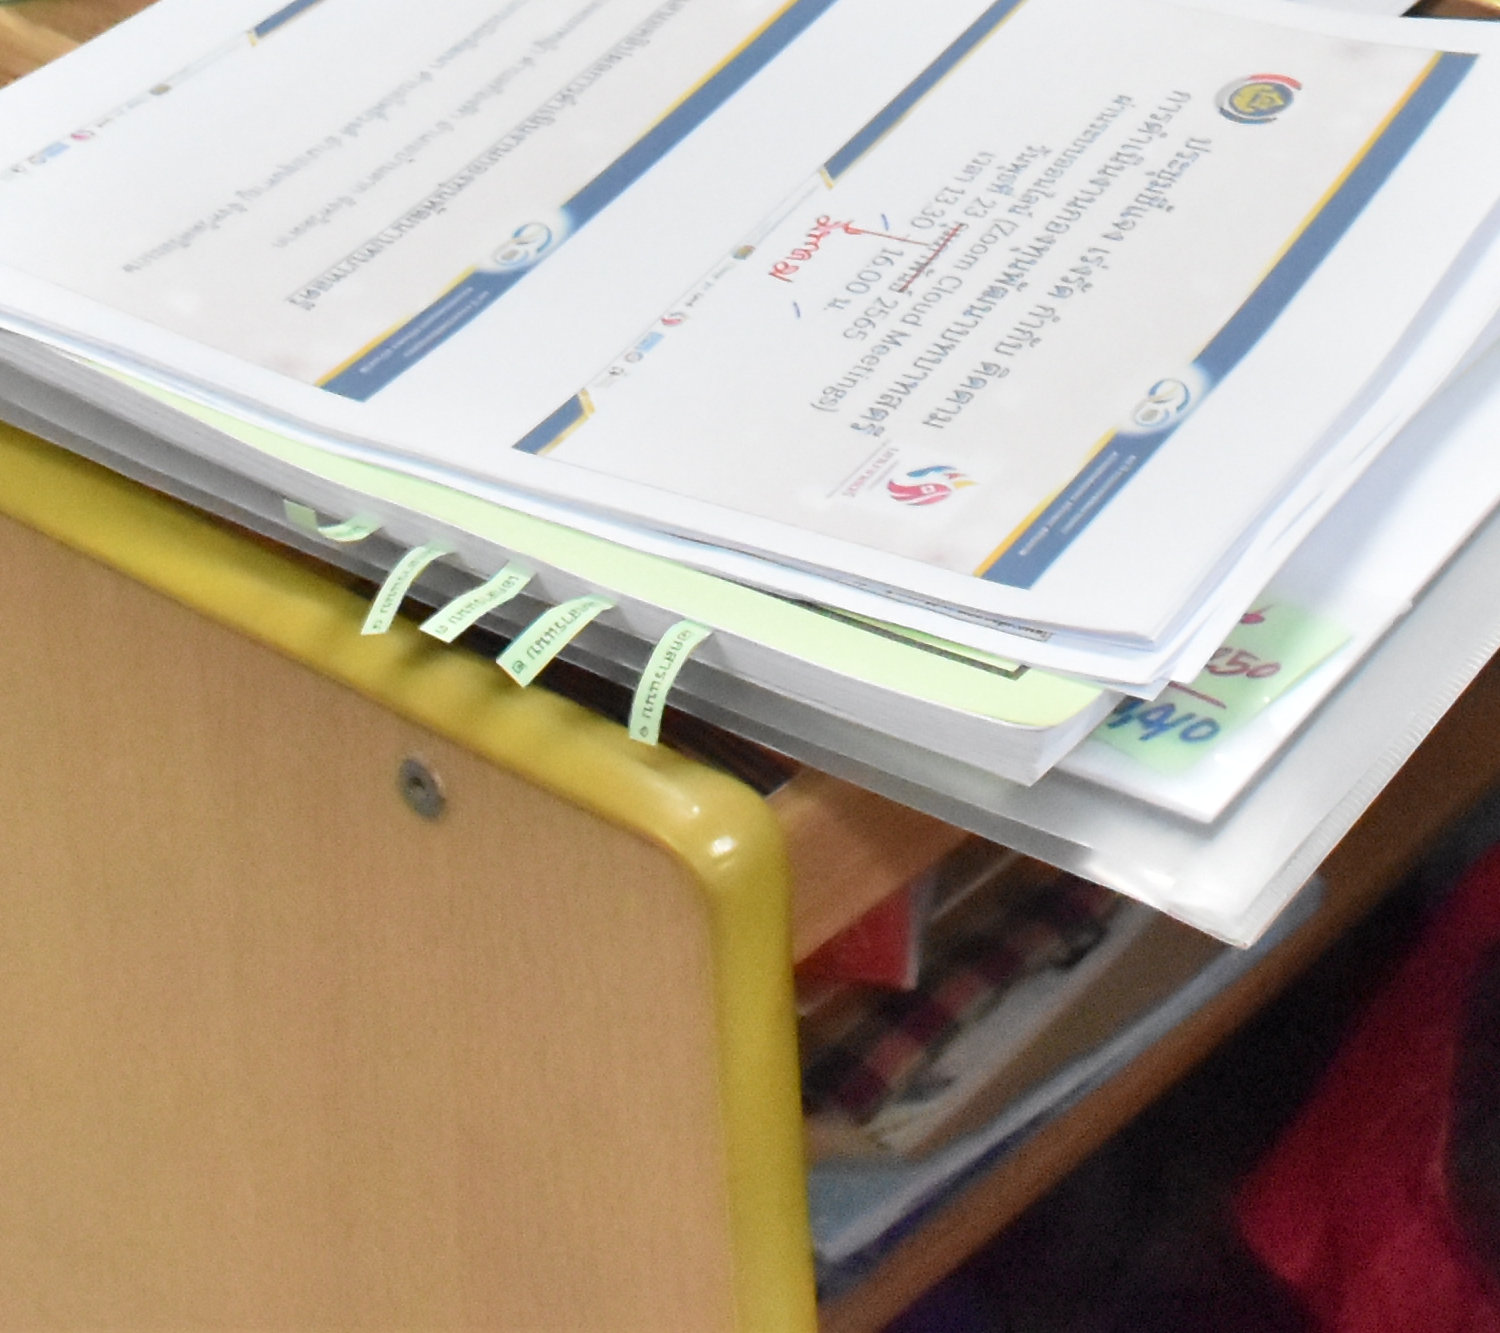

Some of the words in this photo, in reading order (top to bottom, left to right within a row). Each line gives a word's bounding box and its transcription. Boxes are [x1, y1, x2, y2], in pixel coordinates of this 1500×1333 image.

[952, 149, 996, 184] เวลา
[1098, 135, 1213, 242] ประชุมชี้แจง
[907, 184, 967, 230] 13.30
[960, 194, 998, 219] 23
[842, 245, 906, 295] 16.00
[847, 88, 1192, 438] การดำเนินงานกองทุนพัฒนาบทบาทสตรี
[950, 216, 1020, 272] (Zoom
[1044, 245, 1111, 300] เร่งรัด
[840, 294, 900, 341] 2565
[897, 273, 964, 328] Cloud
[991, 302, 1062, 358] กำกับ
[807, 327, 912, 413] Meetings)
[919, 359, 1011, 430] ติดตาม
